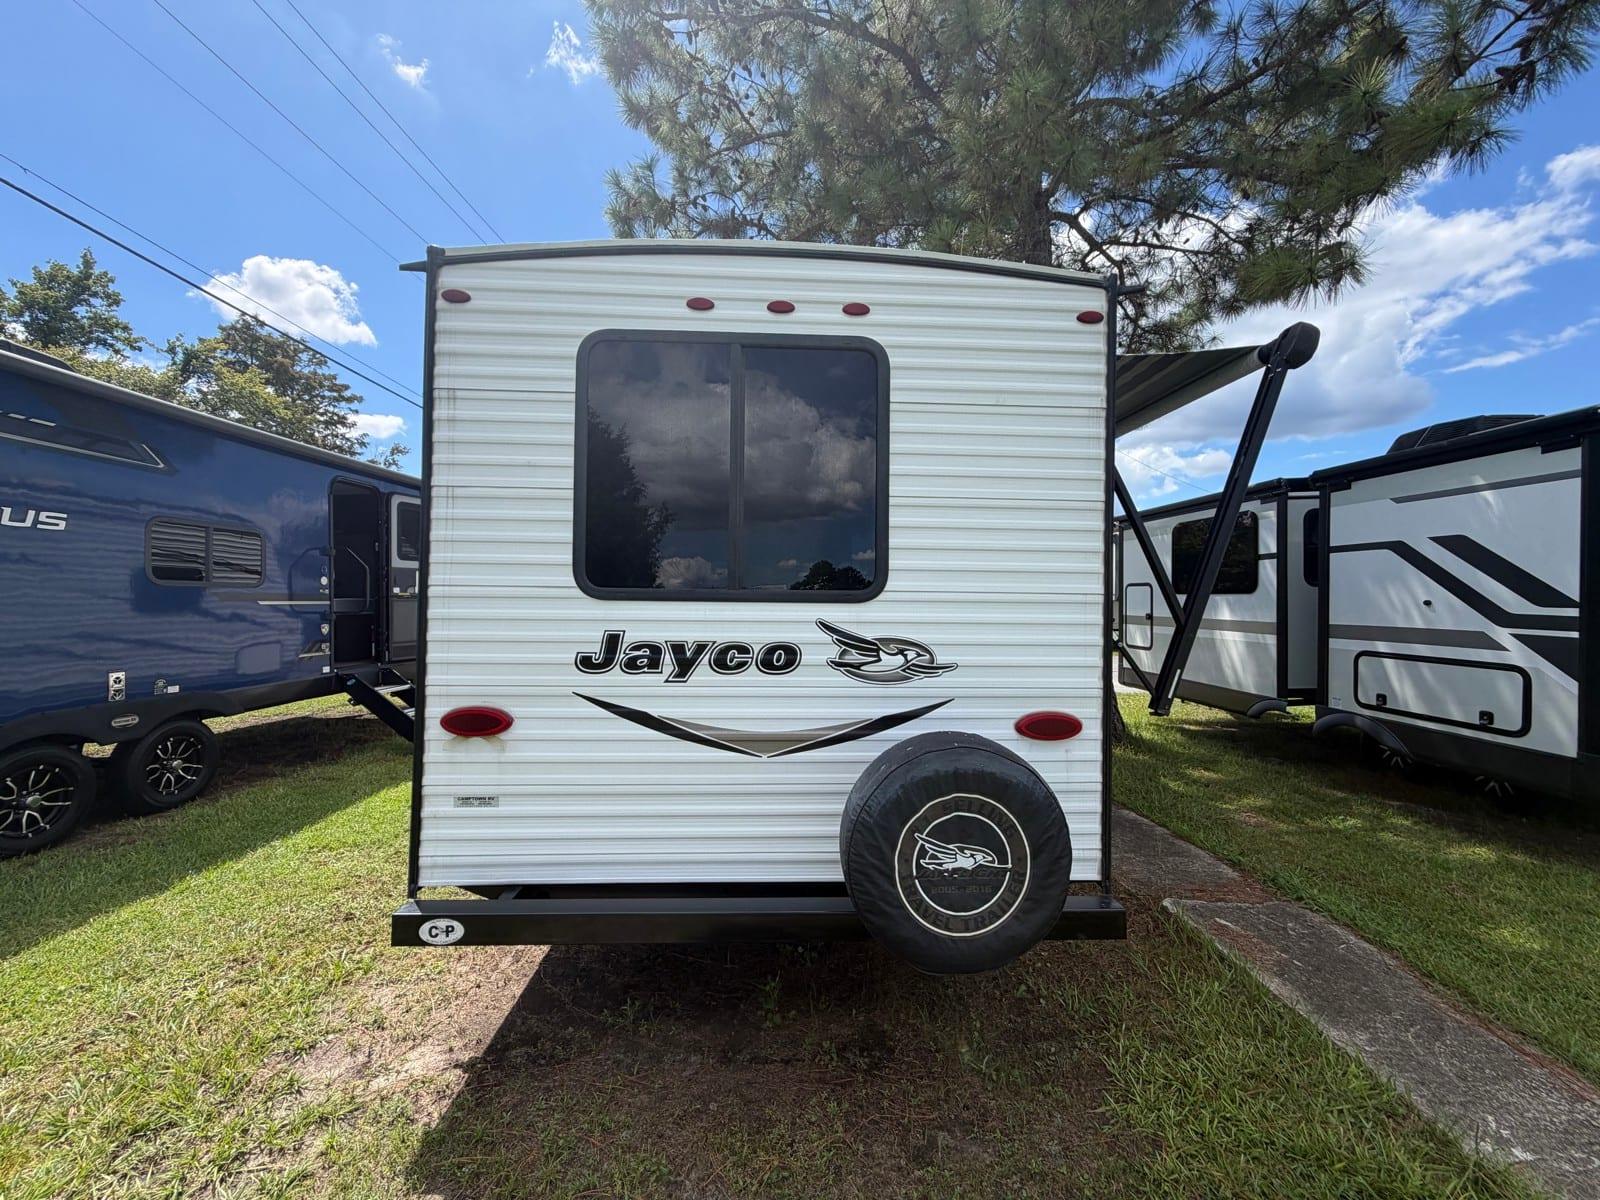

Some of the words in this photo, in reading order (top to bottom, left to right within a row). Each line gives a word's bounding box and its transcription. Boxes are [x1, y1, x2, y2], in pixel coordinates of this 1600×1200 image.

[0, 506, 68, 531] US
[574, 629, 804, 684] Jayco
[942, 799, 1018, 838] SELLING
[960, 871, 1026, 931] TRAILER
